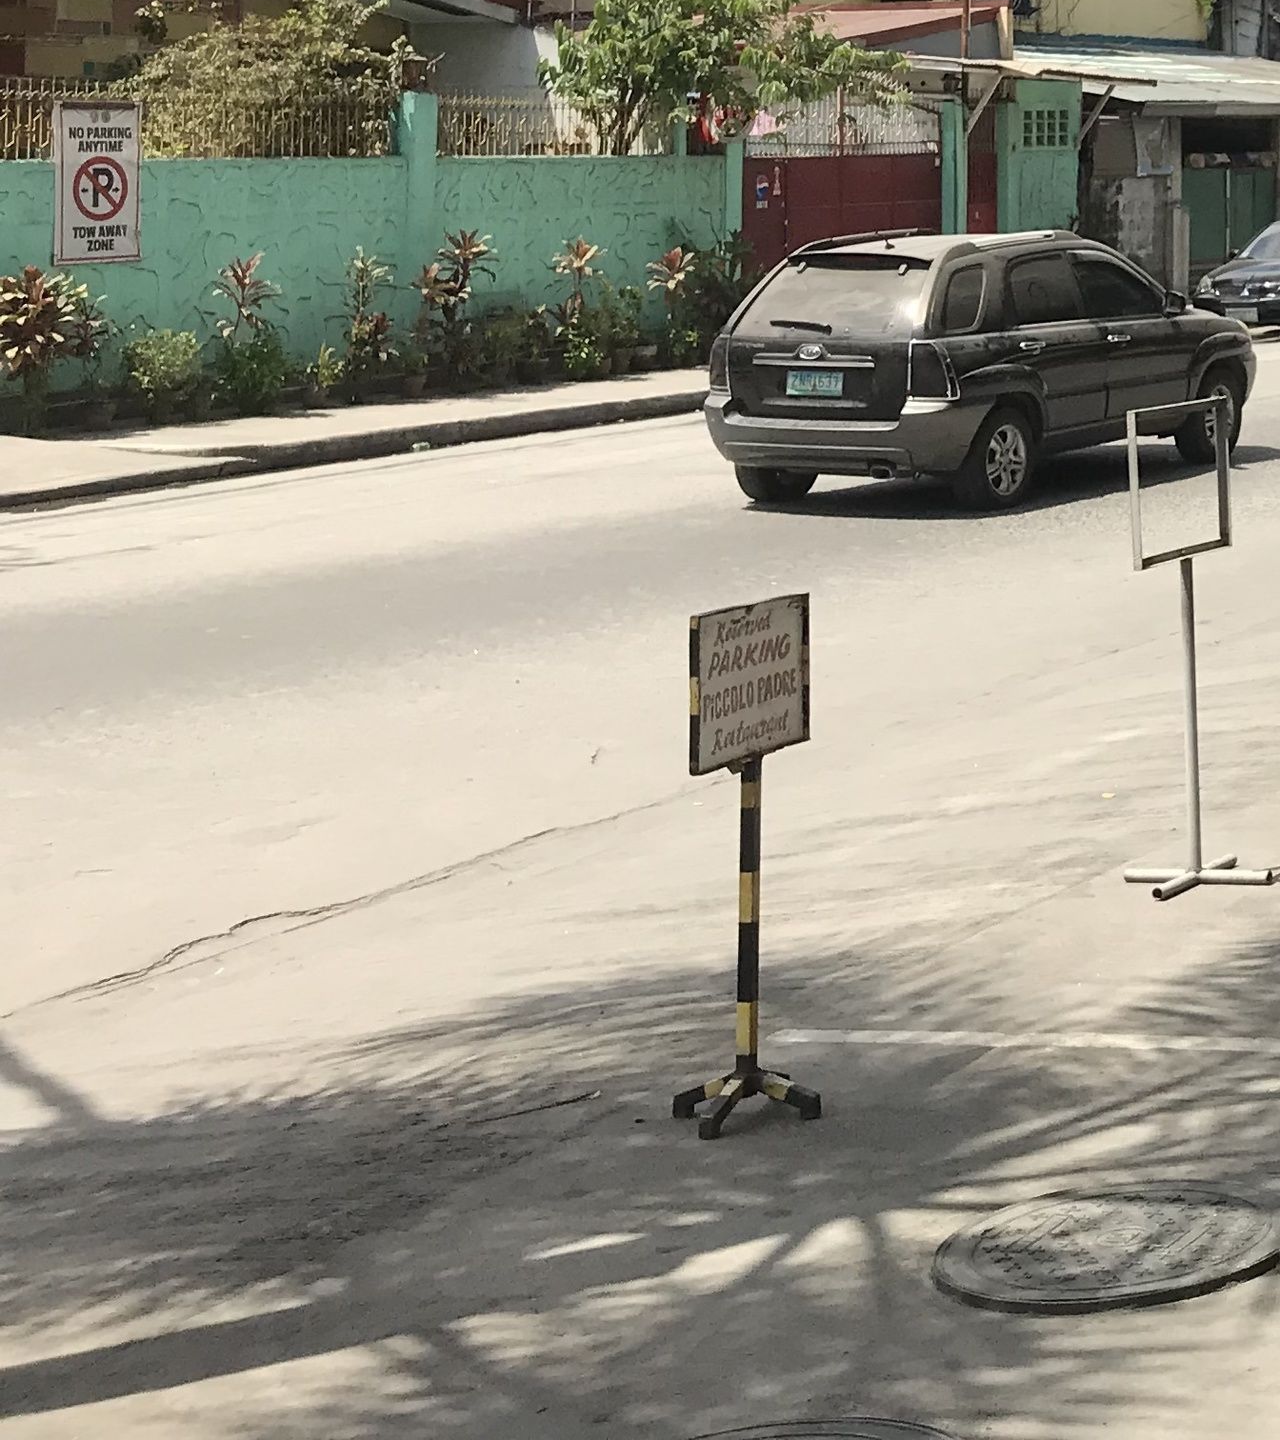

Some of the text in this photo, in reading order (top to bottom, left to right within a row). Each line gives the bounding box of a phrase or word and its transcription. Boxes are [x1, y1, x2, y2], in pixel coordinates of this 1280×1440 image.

[68, 127, 132, 140] NO PARKING
[77, 140, 124, 153] ANYTIME
[72, 224, 128, 239] TOW AWAY
[87, 239, 115, 252] ZONE
[707, 633, 792, 680] PARKING
[757, 667, 797, 705] PADRE
